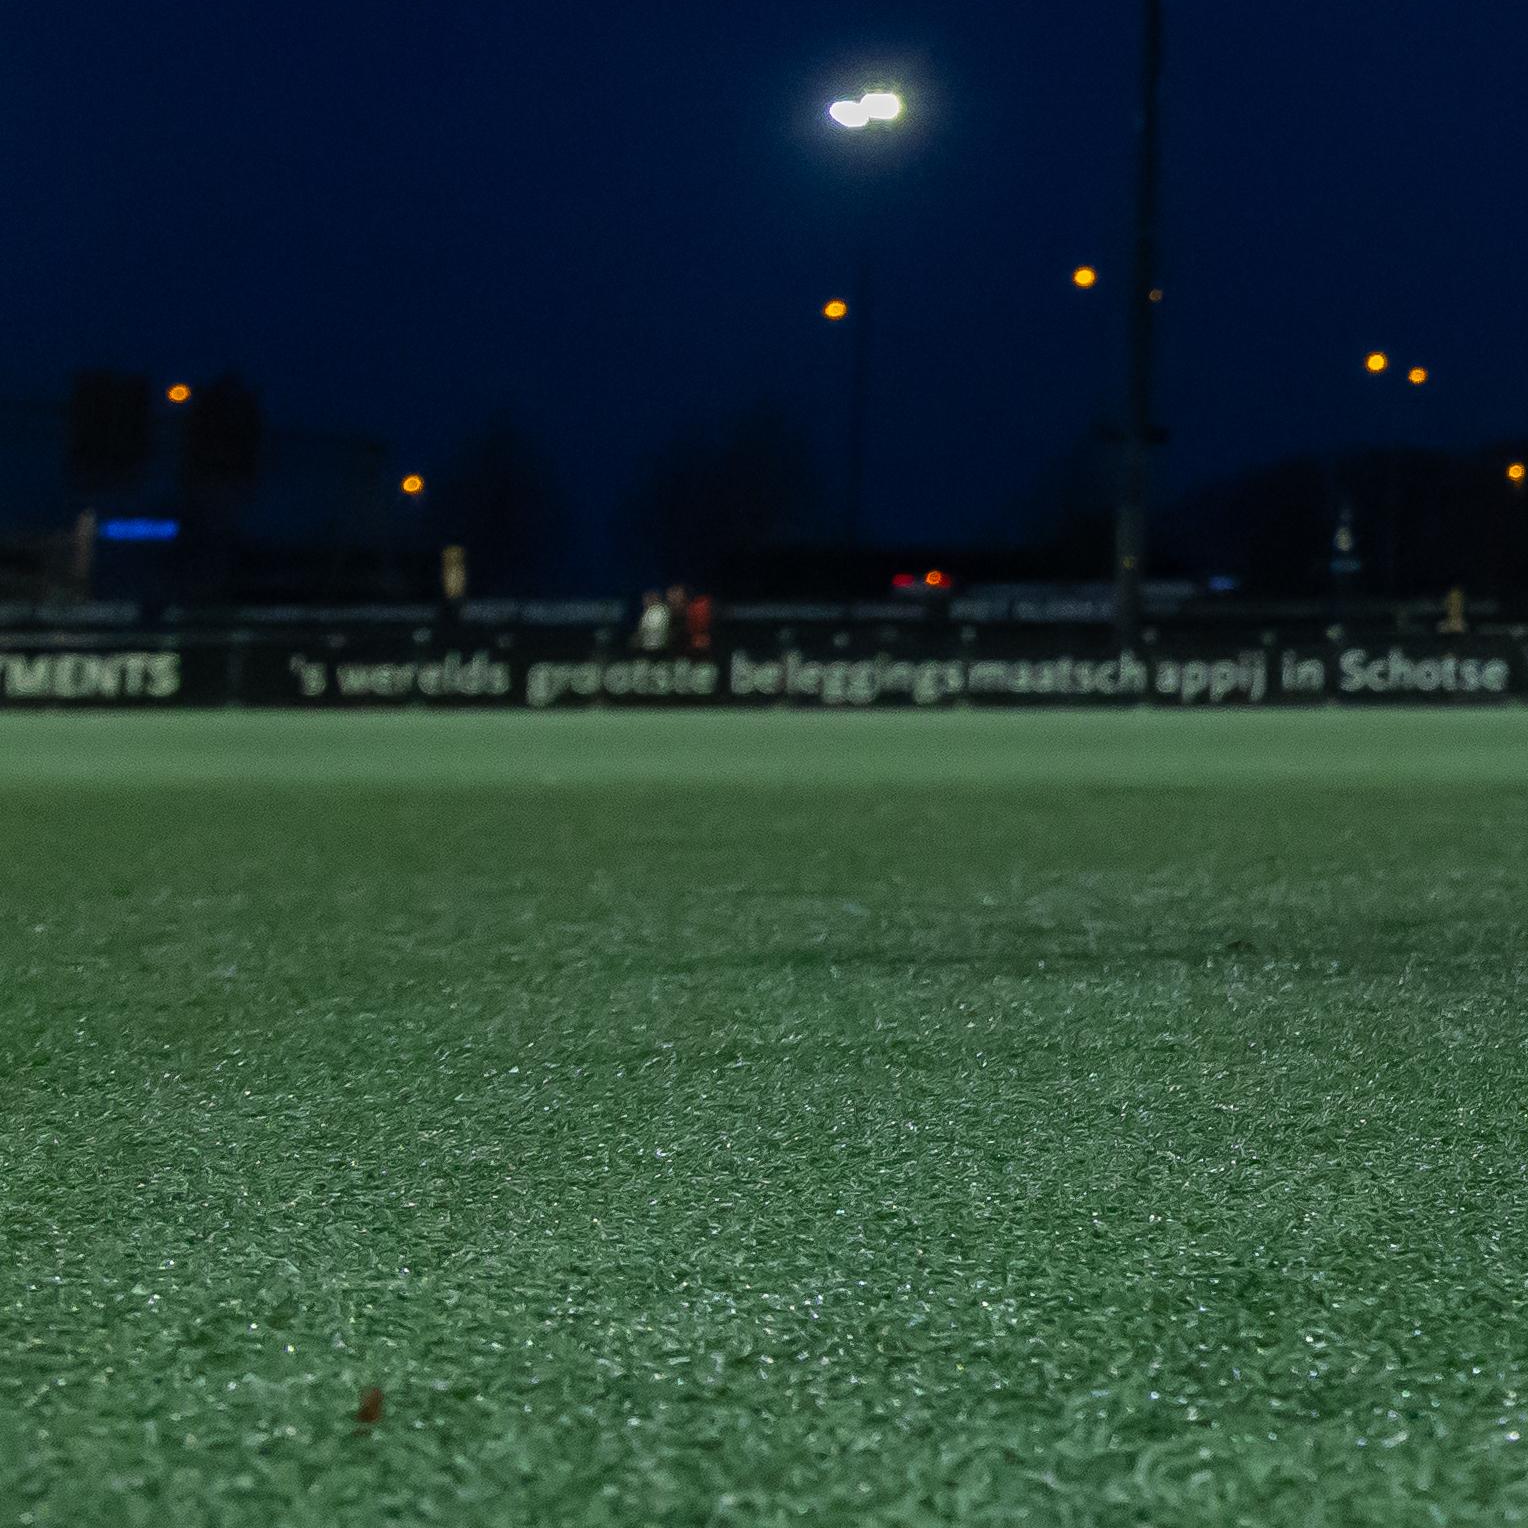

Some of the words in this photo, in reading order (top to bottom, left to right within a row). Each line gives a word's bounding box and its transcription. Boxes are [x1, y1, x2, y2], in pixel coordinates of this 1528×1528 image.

[0, 651, 182, 697] MENTS
[335, 649, 510, 696] werelds
[1281, 648, 1326, 692] in
[1339, 647, 1508, 692] Schotse
